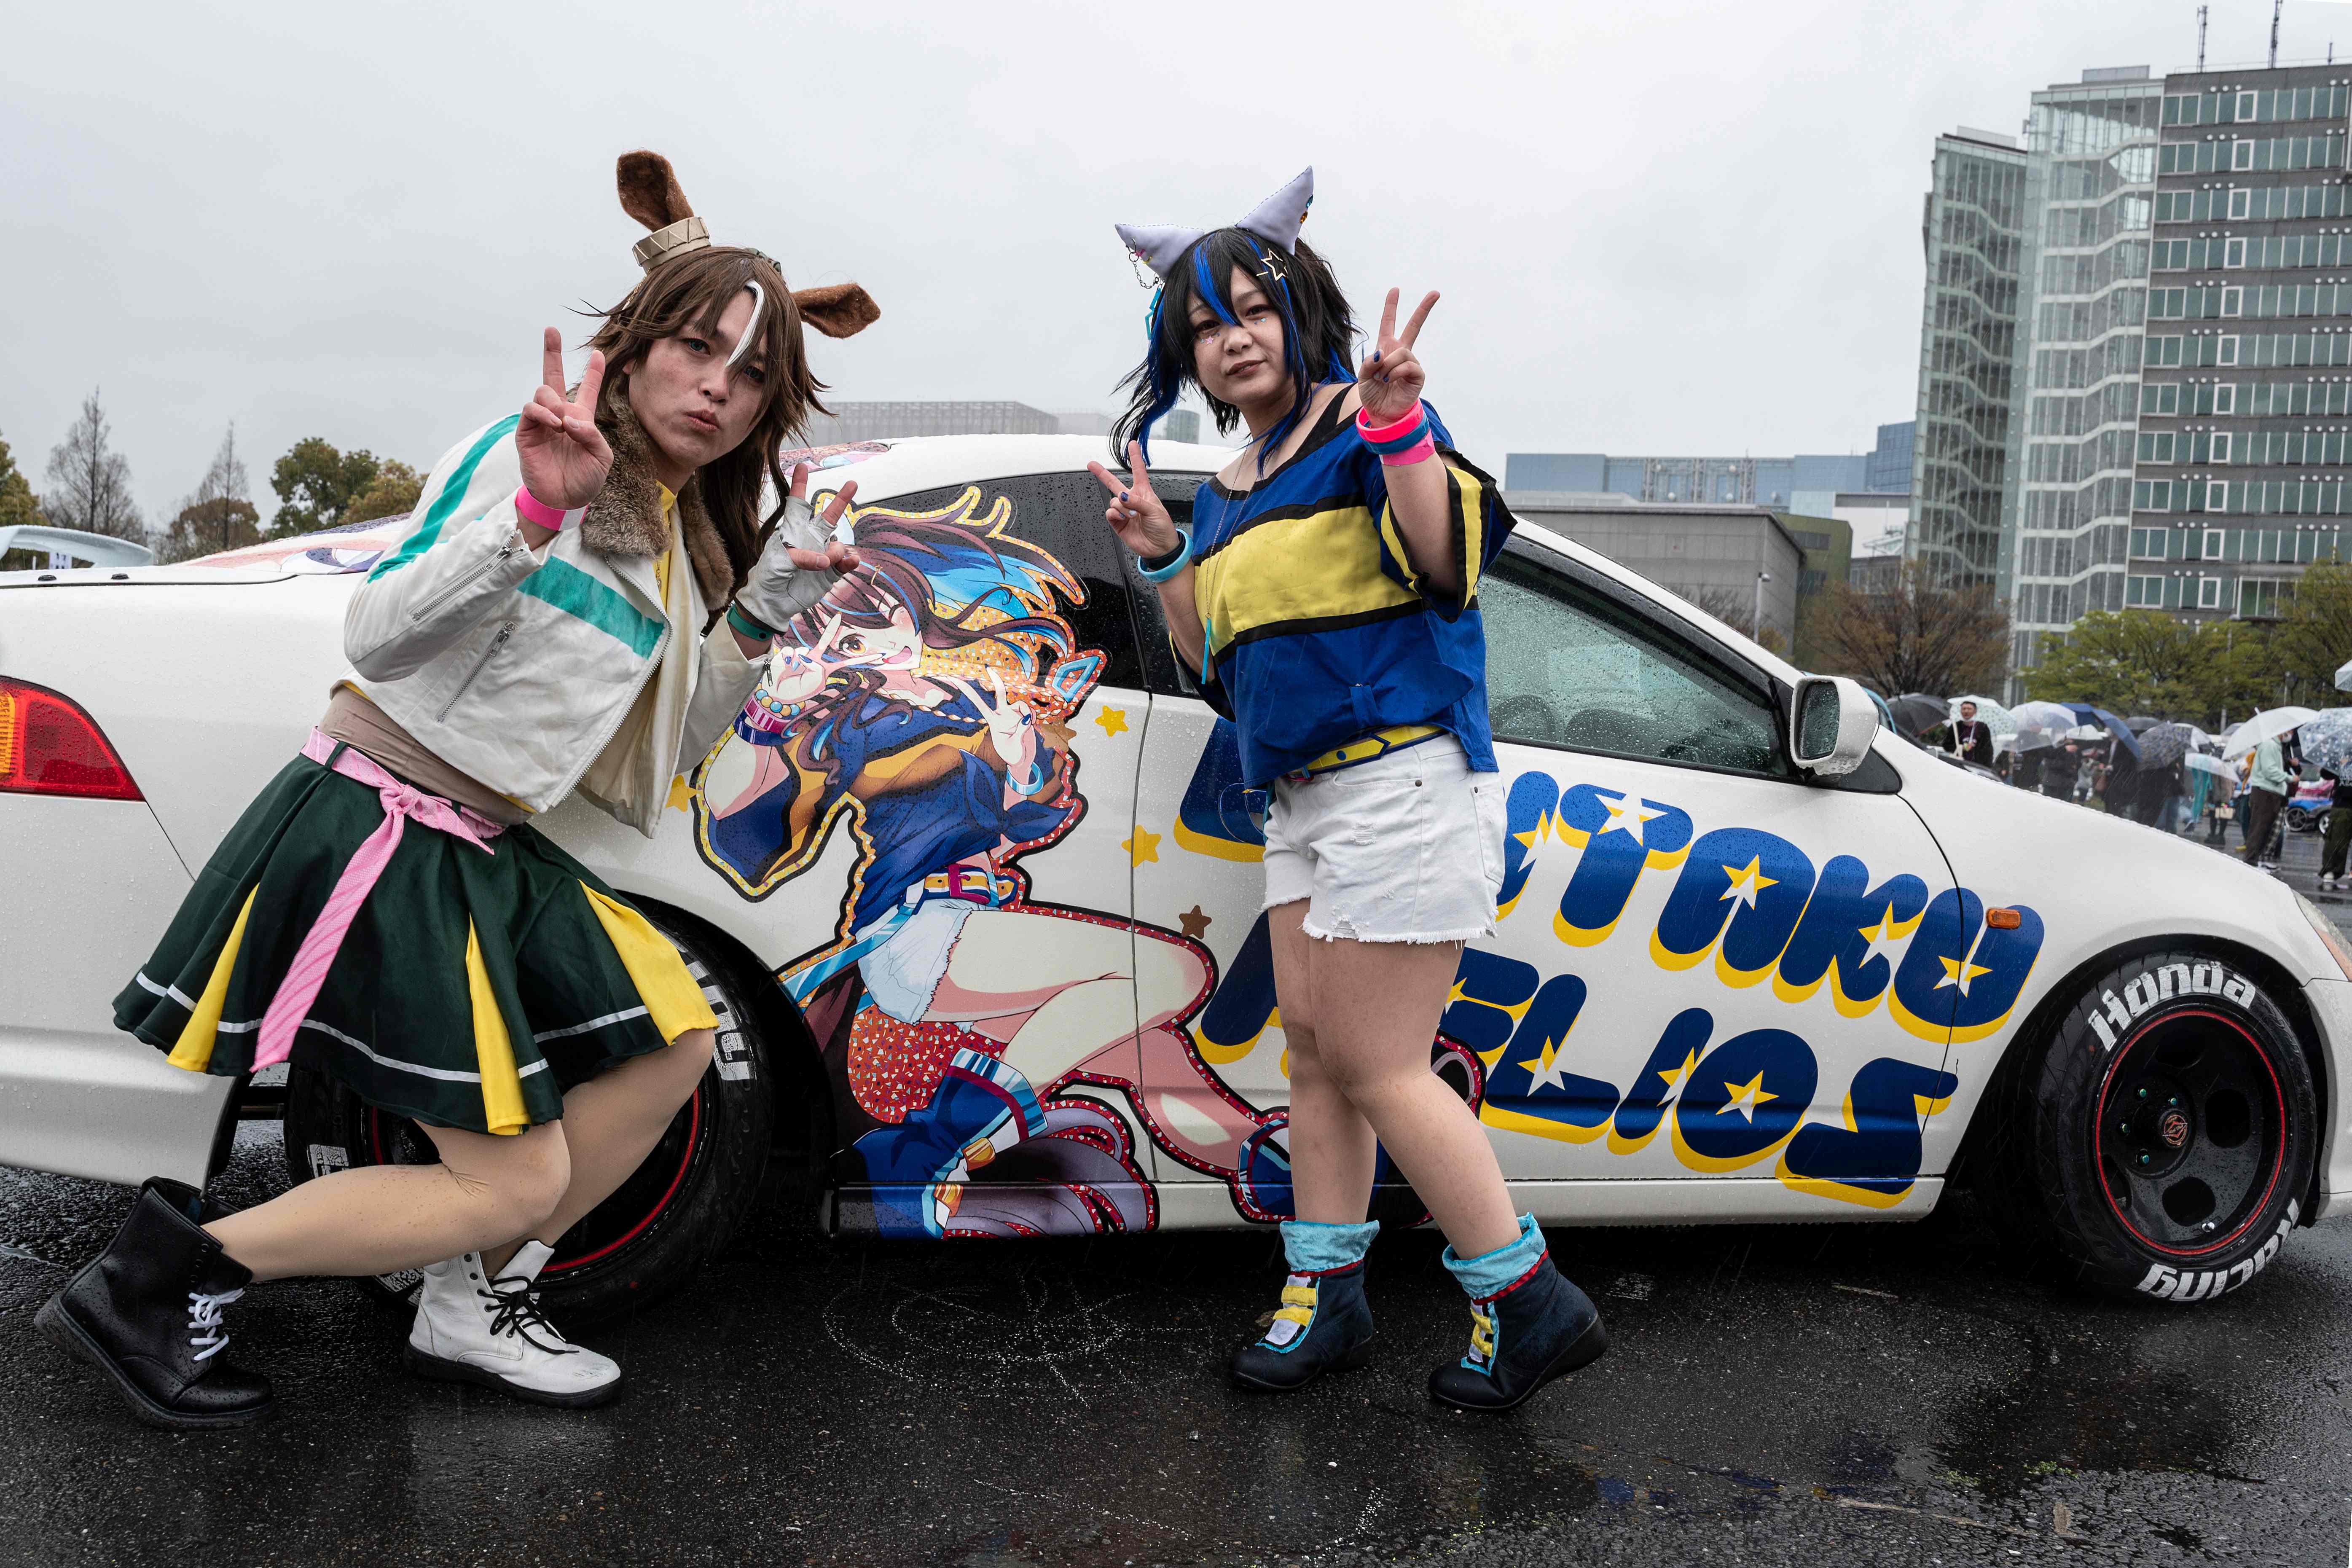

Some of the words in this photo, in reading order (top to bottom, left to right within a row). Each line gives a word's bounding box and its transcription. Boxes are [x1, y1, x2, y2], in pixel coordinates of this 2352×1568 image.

[1173, 713, 2044, 1044] ITAKU
[2089, 961, 2255, 1051] Honda
[1194, 910, 1959, 1209] LIOS
